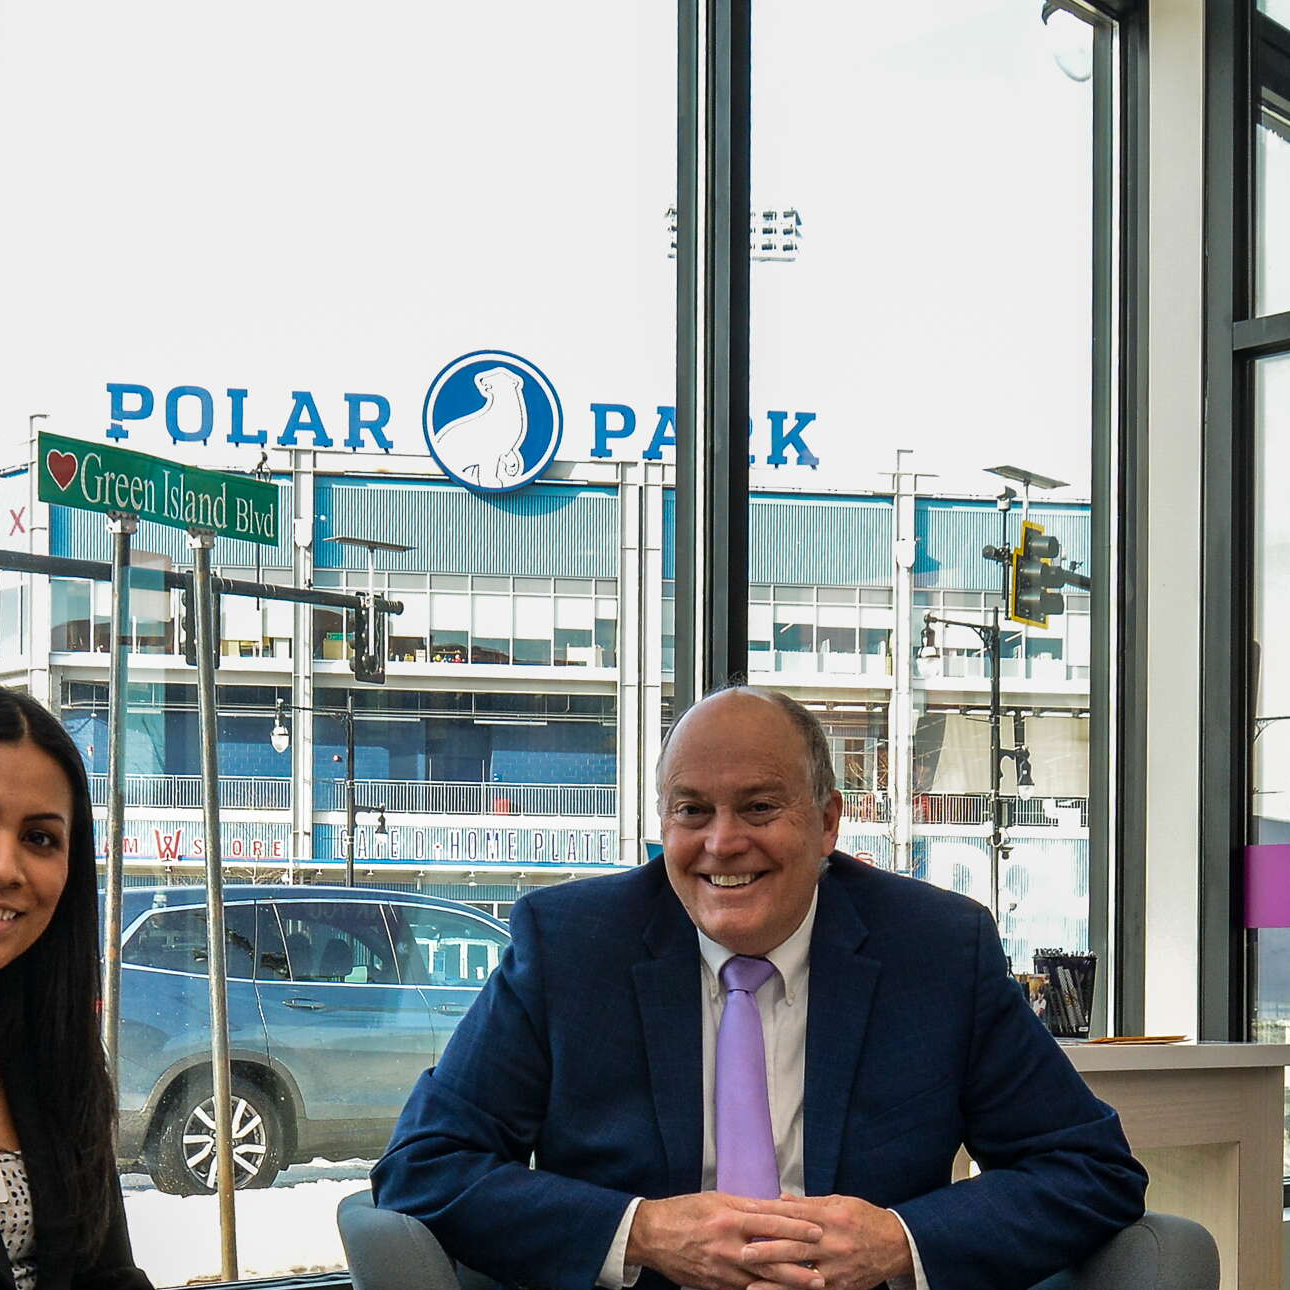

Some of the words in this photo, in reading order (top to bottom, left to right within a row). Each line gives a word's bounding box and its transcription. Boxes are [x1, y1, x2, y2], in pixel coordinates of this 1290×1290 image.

[106, 383, 394, 449] POLAR
[590, 403, 819, 466] PAK
[80, 452, 157, 514] Green
[162, 469, 228, 529] Island
[236, 496, 275, 539] Blvd
[193, 839, 283, 858] SORE
[450, 831, 517, 861] HOME
[534, 832, 608, 863] PLATE
